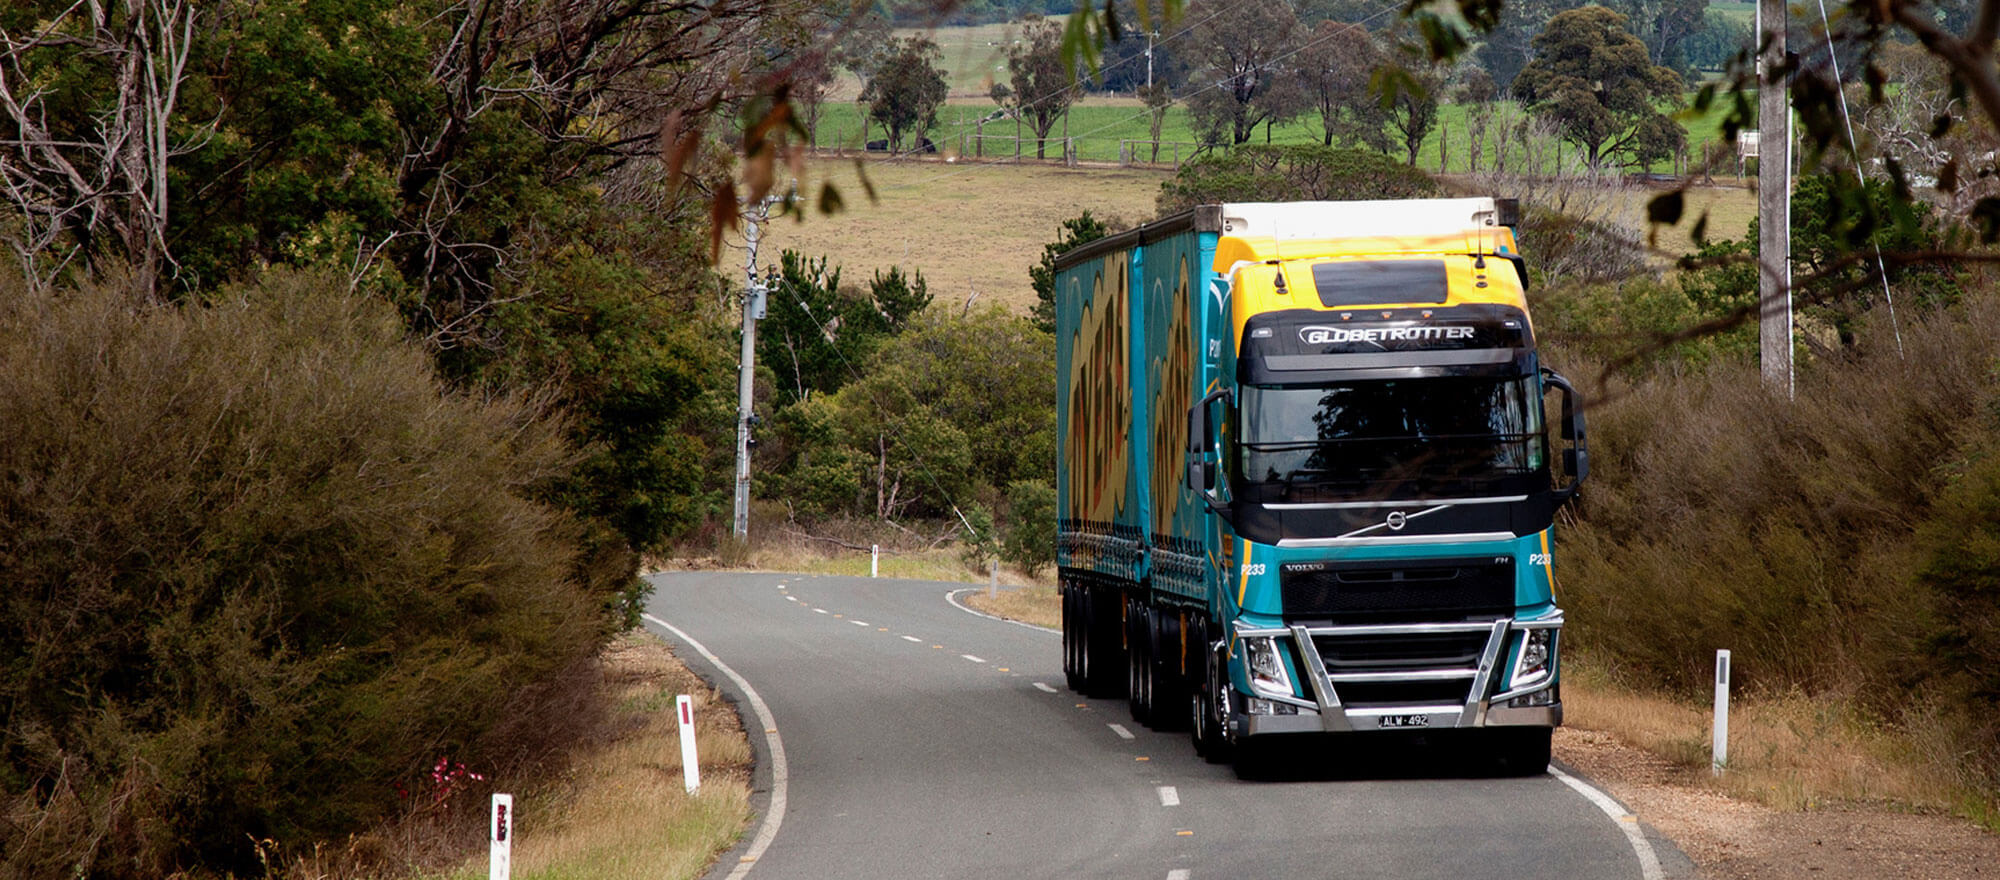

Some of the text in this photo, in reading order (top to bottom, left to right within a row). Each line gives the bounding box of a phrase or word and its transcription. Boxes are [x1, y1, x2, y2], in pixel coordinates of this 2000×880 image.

[1308, 326, 1475, 344] GLOBETROTTER
[1240, 563, 1266, 576] P233
[1286, 563, 1325, 572] VOLVO
